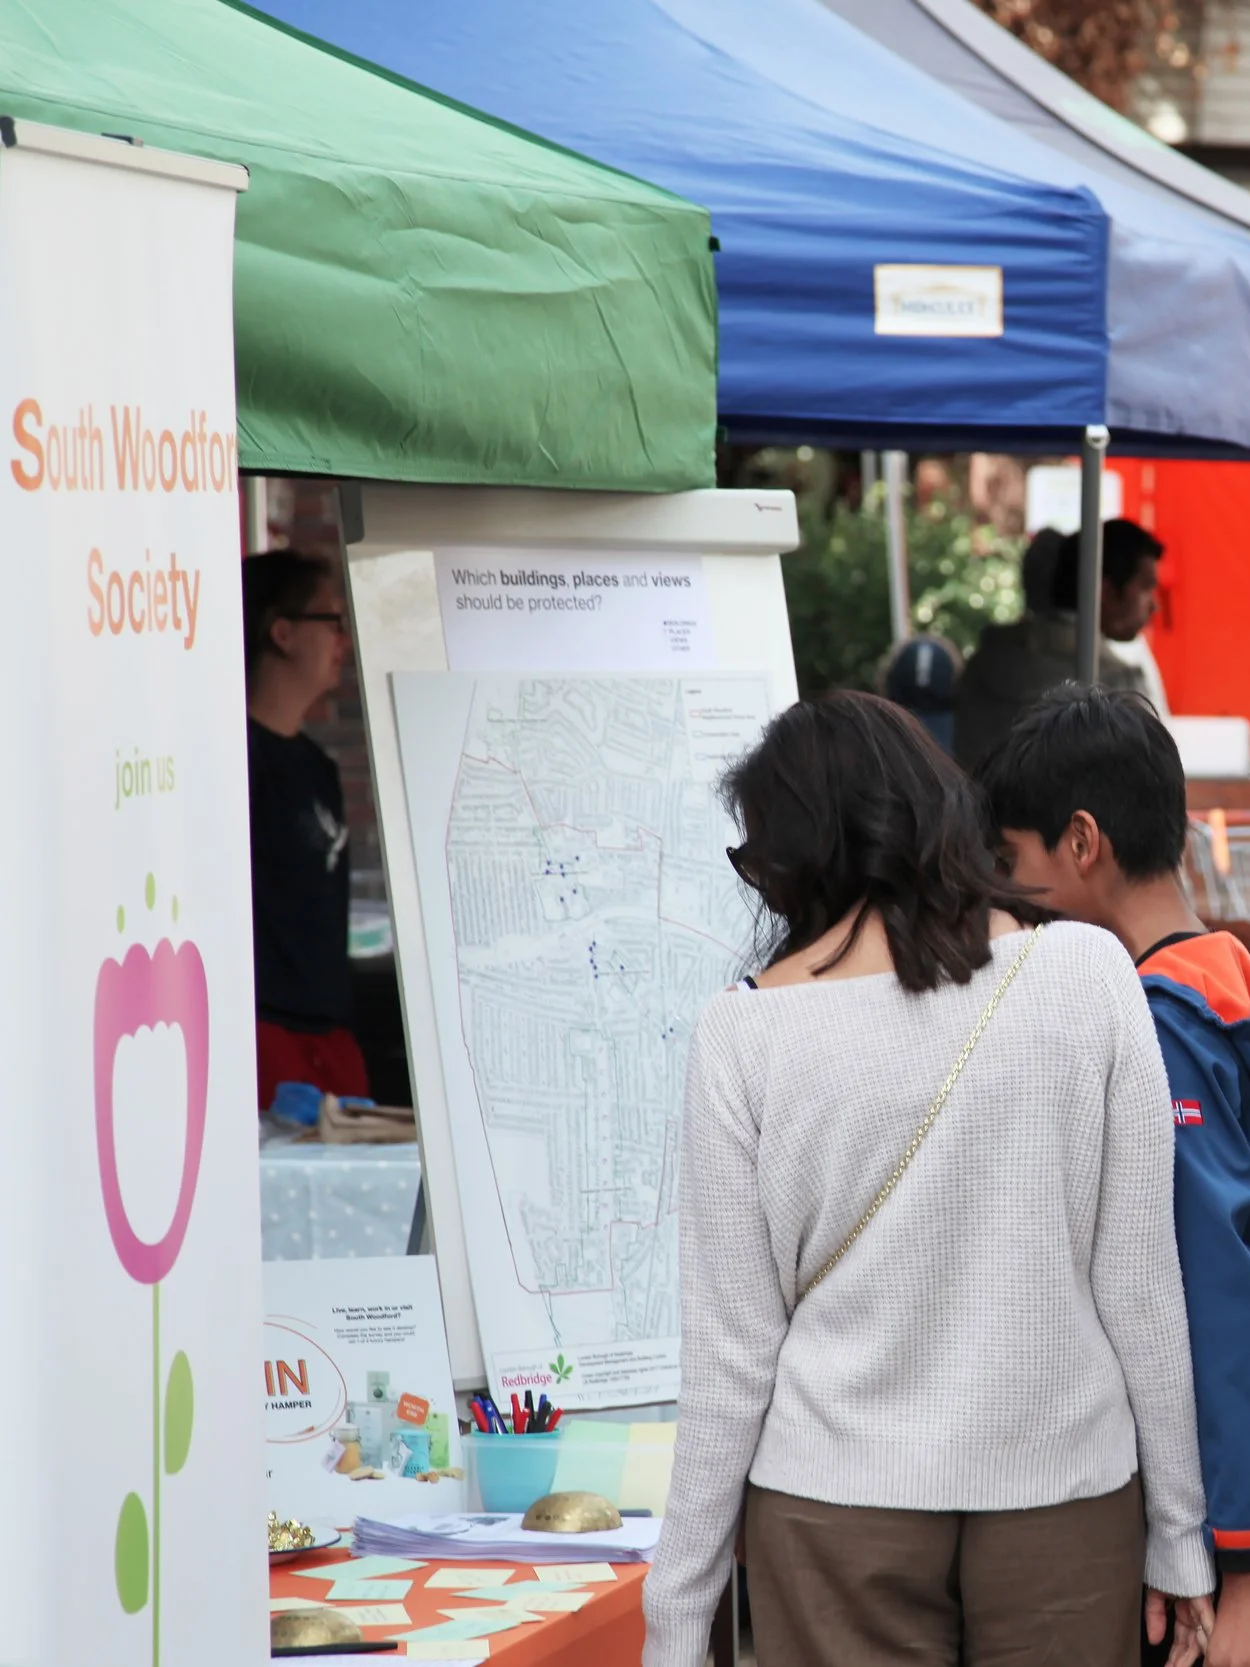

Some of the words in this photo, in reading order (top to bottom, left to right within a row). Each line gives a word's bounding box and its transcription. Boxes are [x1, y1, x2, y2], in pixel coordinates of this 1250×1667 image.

[10, 398, 105, 493] South
[110, 403, 237, 493] Woodfor
[451, 568, 497, 586] Which
[499, 569, 570, 590] buildings,
[572, 570, 620, 590] places
[621, 572, 649, 588] and
[650, 572, 692, 588] views
[86, 547, 201, 651] Society
[455, 593, 503, 611] should
[505, 594, 524, 611] be
[528, 594, 603, 614] protected?
[114, 746, 153, 811] join
[157, 755, 176, 792] us
[346, 1313, 365, 1321] South
[365, 1312, 401, 1320] Woodford?
[502, 1372, 552, 1388] Redbridge
[271, 1400, 312, 1411] HAMPER
